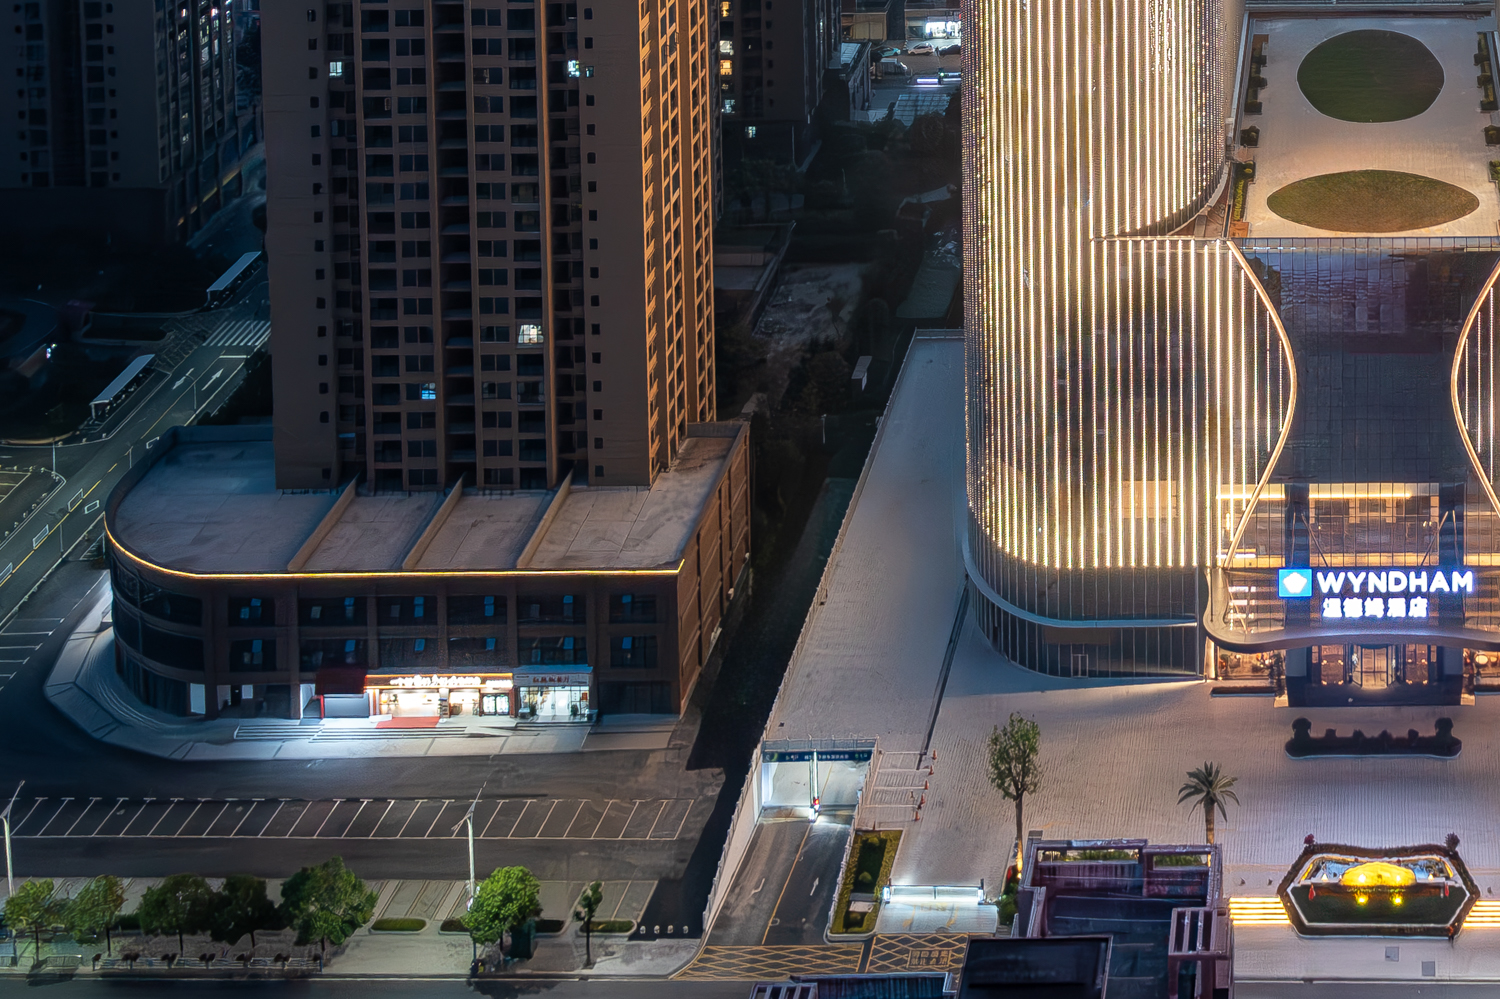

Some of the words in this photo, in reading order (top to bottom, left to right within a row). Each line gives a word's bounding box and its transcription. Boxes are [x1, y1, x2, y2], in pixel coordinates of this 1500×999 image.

[1316, 571, 1474, 593] WYNDHAM
[1322, 596, 1428, 618] 温德姆酒店
